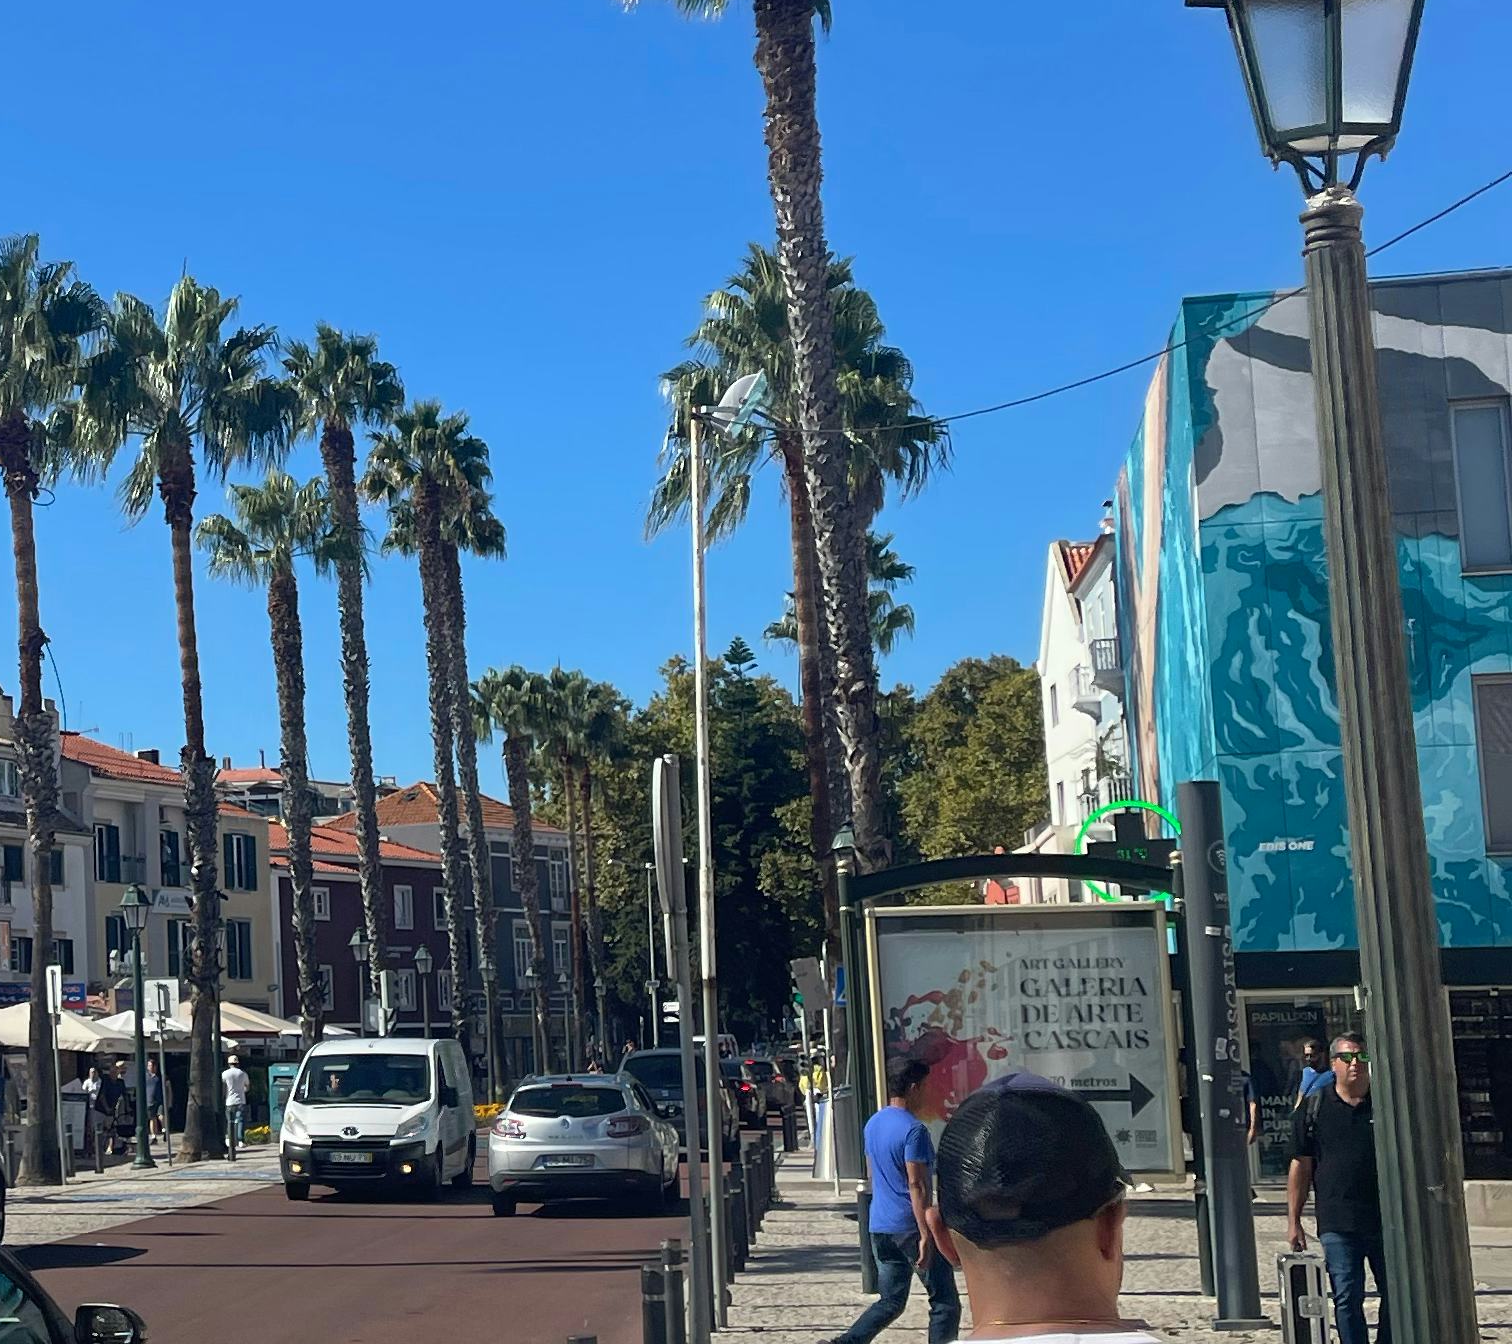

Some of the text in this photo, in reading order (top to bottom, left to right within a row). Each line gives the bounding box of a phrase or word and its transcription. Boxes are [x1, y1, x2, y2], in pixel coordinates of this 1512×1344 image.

[1288, 840, 1315, 851] ONE
[1019, 957, 1125, 970] ART GALLERY
[1020, 976, 1148, 998] GALERIA
[1022, 1003, 1144, 1024] DE ARTE
[1023, 1029, 1151, 1050] CASCAIS
[1070, 1074, 1118, 1088] metros
[1262, 1107, 1276, 1119] IN
[1263, 1120, 1293, 1131] PUR
